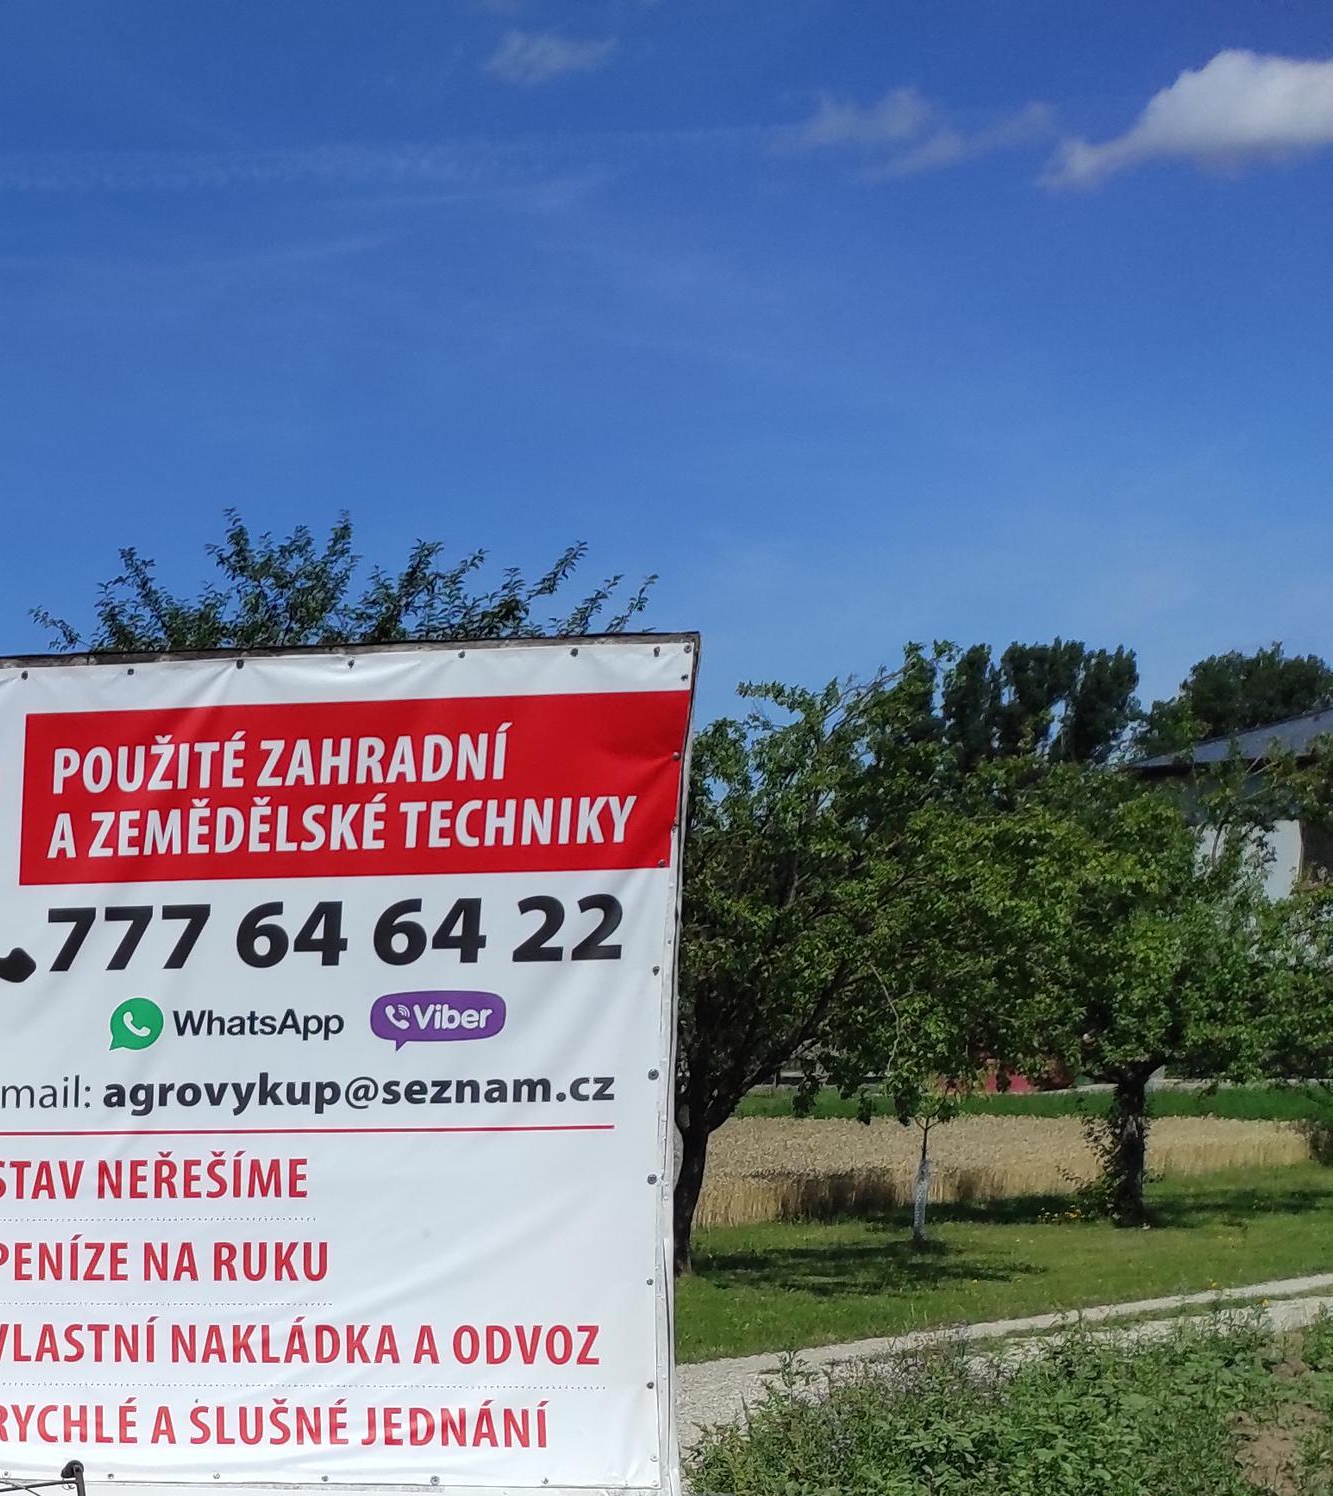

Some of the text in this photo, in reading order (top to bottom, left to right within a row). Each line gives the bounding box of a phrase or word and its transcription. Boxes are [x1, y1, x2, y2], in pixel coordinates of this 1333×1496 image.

[52, 722, 512, 796] POUŽITÉ ZAHRADNÍ
[47, 792, 637, 859] A ZEMĚDĚLSKÉ TECHNIKY
[47, 893, 623, 972] 777 64 64 22
[172, 1008, 345, 1041] WhatsApp
[413, 1003, 492, 1032] Viber
[103, 1072, 615, 1117] agrovykup@seznam.cz
[97, 1151, 307, 1200] NEŘEŠÍME
[143, 1242, 198, 1281] NA
[213, 1241, 328, 1282] RUKU
[171, 1316, 400, 1364] NAKLÁDKA
[413, 1324, 439, 1364] A
[452, 1324, 599, 1366] ODVOZ
[151, 1406, 176, 1445] A
[190, 1399, 347, 1445] SLUŠNÉ
[361, 1400, 547, 1448] JEDNÁNÍ
